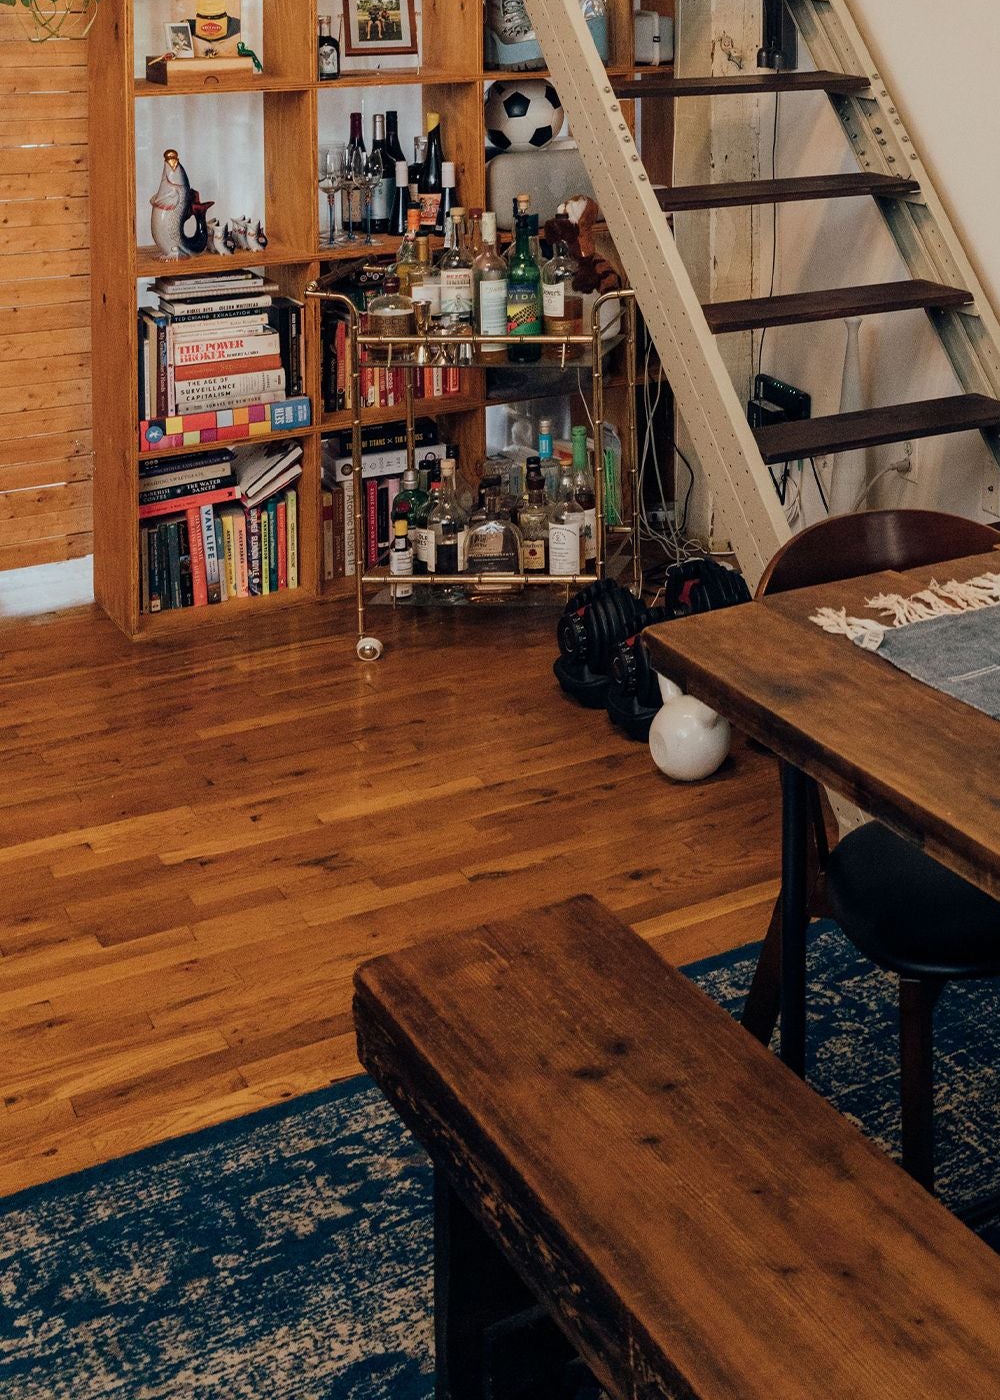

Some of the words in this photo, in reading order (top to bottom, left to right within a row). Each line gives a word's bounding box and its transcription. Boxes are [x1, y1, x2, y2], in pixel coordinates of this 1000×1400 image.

[508, 293, 537, 301] VIDA
[213, 310, 251, 319] EXHALATION
[179, 342, 202, 355] THE
[206, 339, 244, 351] POWER
[179, 350, 226, 363] BROKER
[180, 383, 236, 395] SURVEILLANCE
[188, 380, 200, 388] THE
[186, 391, 231, 401] CAPITALISM
[199, 479, 221, 487] WATER
[192, 485, 216, 494] DANCER
[204, 509, 212, 531] VAN
[206, 534, 215, 559] LIFE
